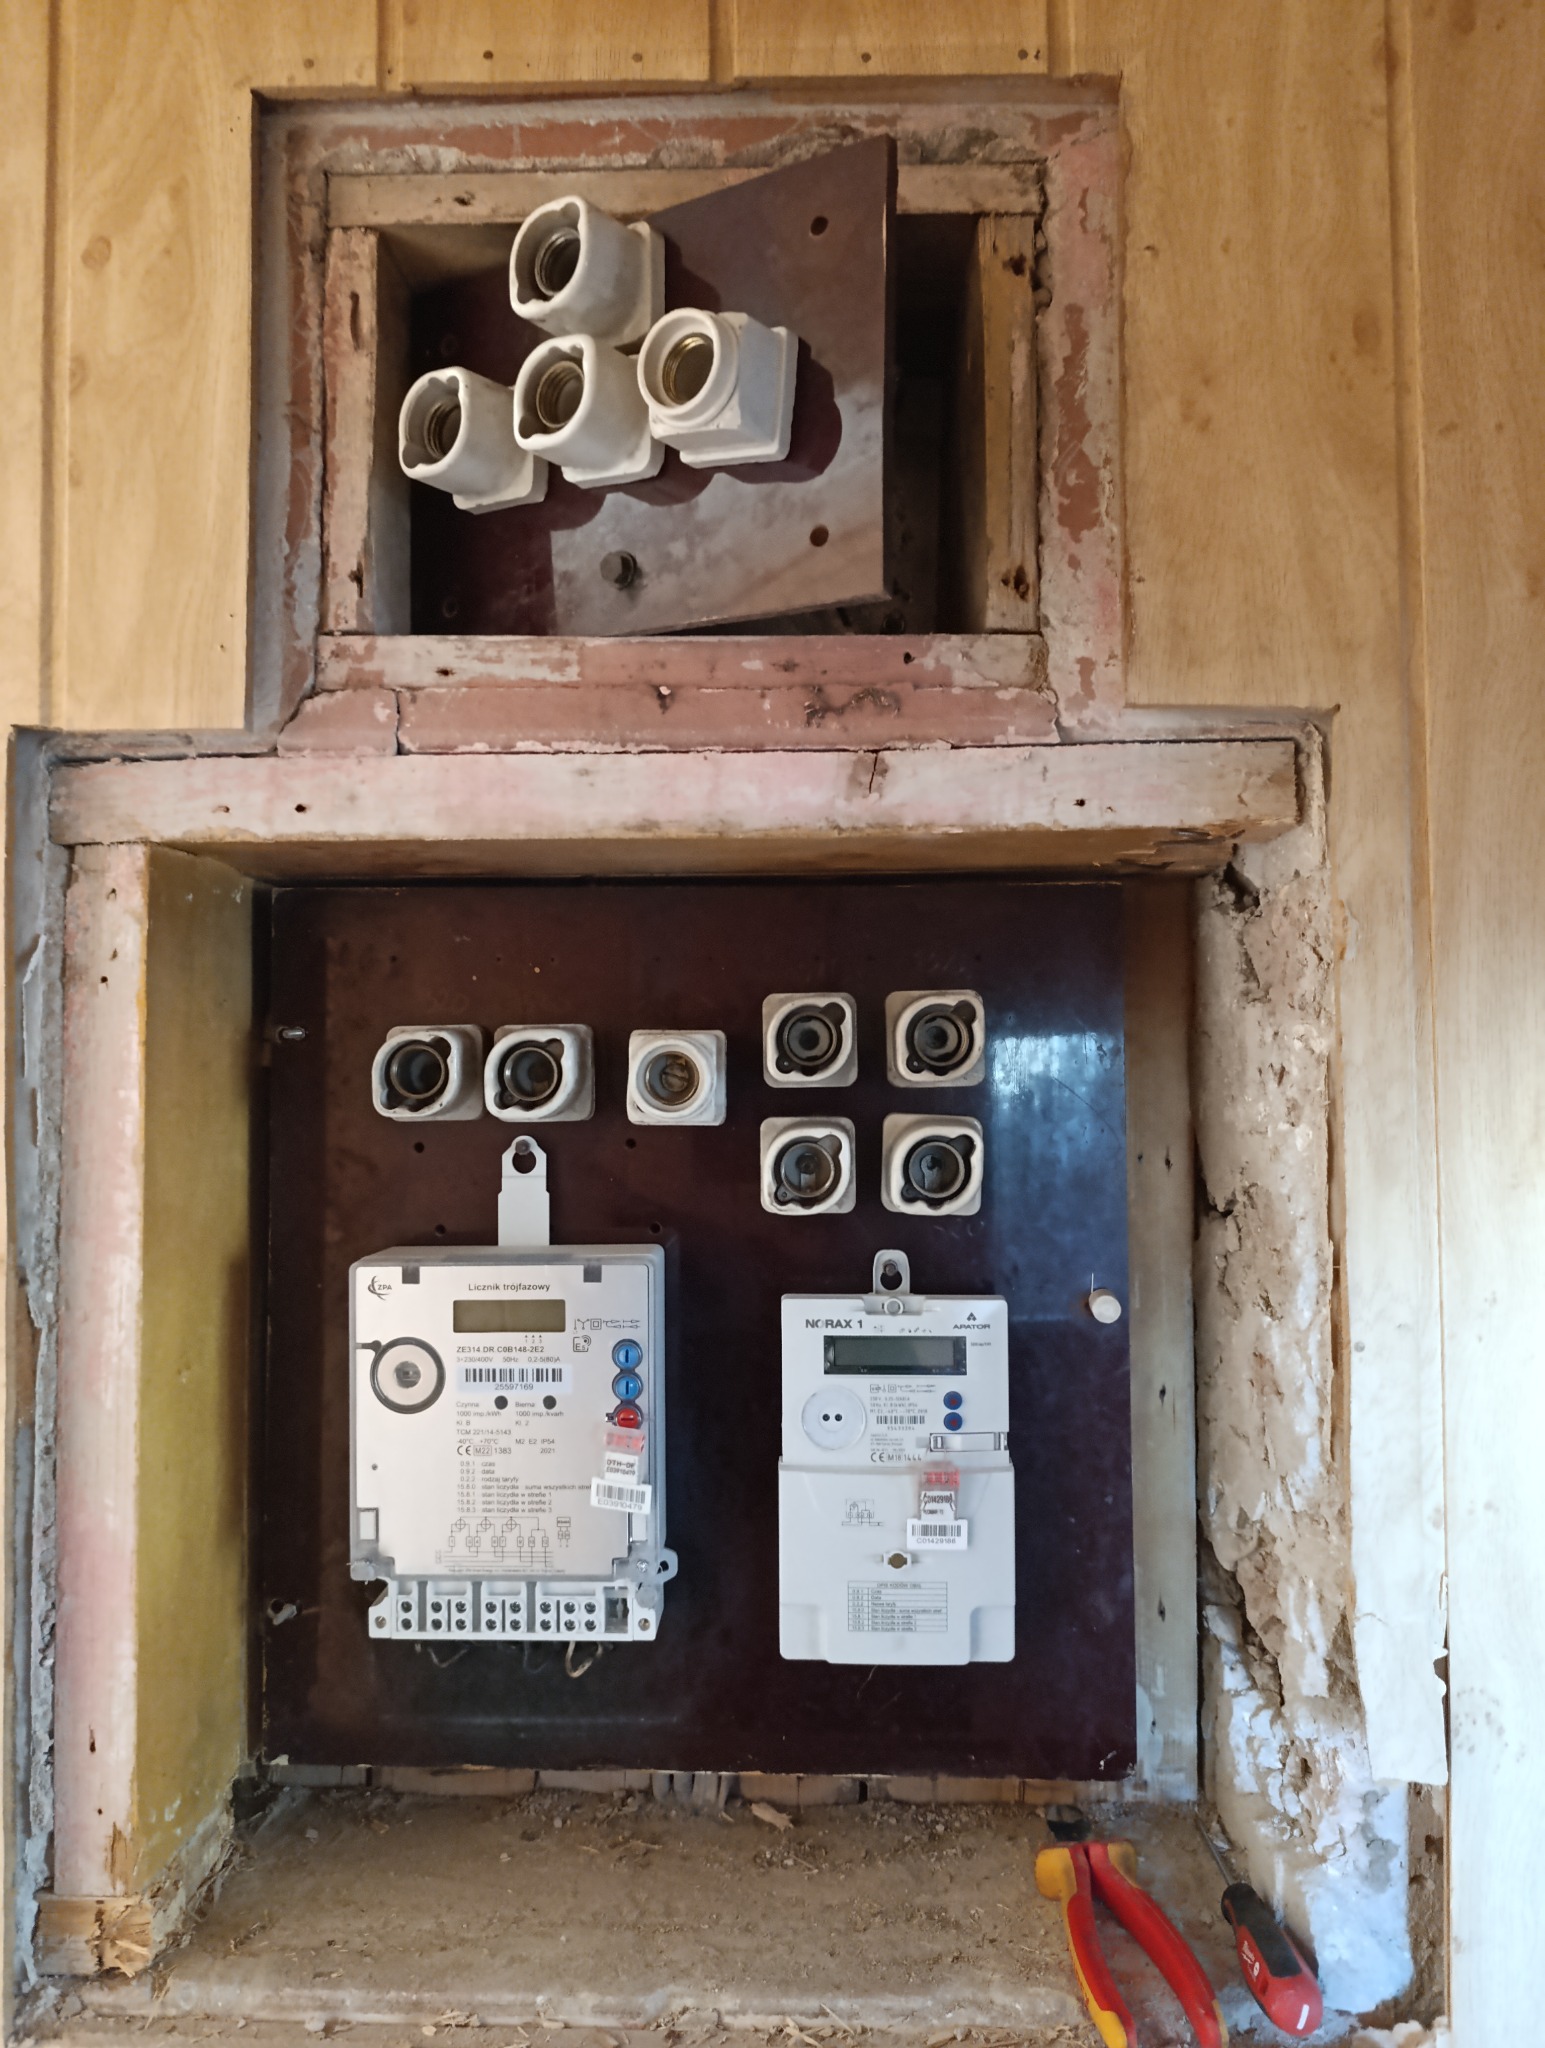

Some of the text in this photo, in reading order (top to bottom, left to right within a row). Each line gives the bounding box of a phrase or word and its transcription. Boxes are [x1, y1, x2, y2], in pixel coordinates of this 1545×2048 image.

[468, 1283, 550, 1293] Licznik trójfazowy
[805, 1319, 853, 1329] NORAX
[495, 1383, 534, 1391] 25597169
[475, 1447, 491, 1455] M22
[494, 1447, 512, 1455] 1383
